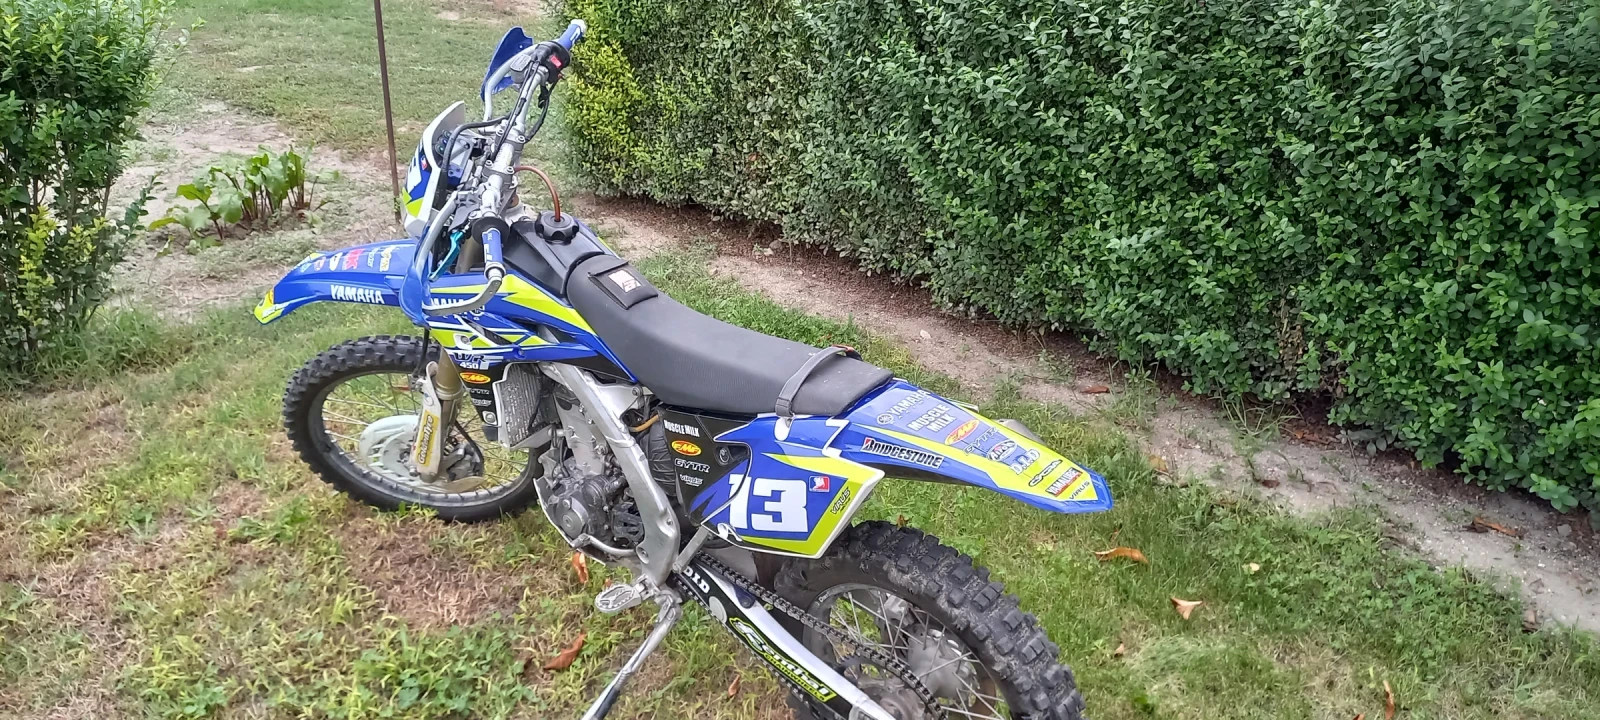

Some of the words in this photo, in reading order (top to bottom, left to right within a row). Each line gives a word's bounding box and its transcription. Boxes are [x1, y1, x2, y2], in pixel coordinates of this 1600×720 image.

[330, 285, 385, 305] YAMAHA
[460, 361, 479, 369] 450
[887, 389, 931, 415] YAMAHA
[908, 403, 951, 431] MUSCLE
[927, 413, 957, 432] MILK
[663, 419, 685, 434] MUSCLE
[684, 424, 700, 437] MILK
[947, 420, 977, 444] FMF
[672, 442, 700, 454] FMF
[863, 437, 944, 468] BRIDGESTONE
[675, 458, 710, 473] GYTR
[832, 487, 851, 514] VIRUS
[1069, 481, 1090, 500] VIRUS
[728, 473, 809, 533] 13
